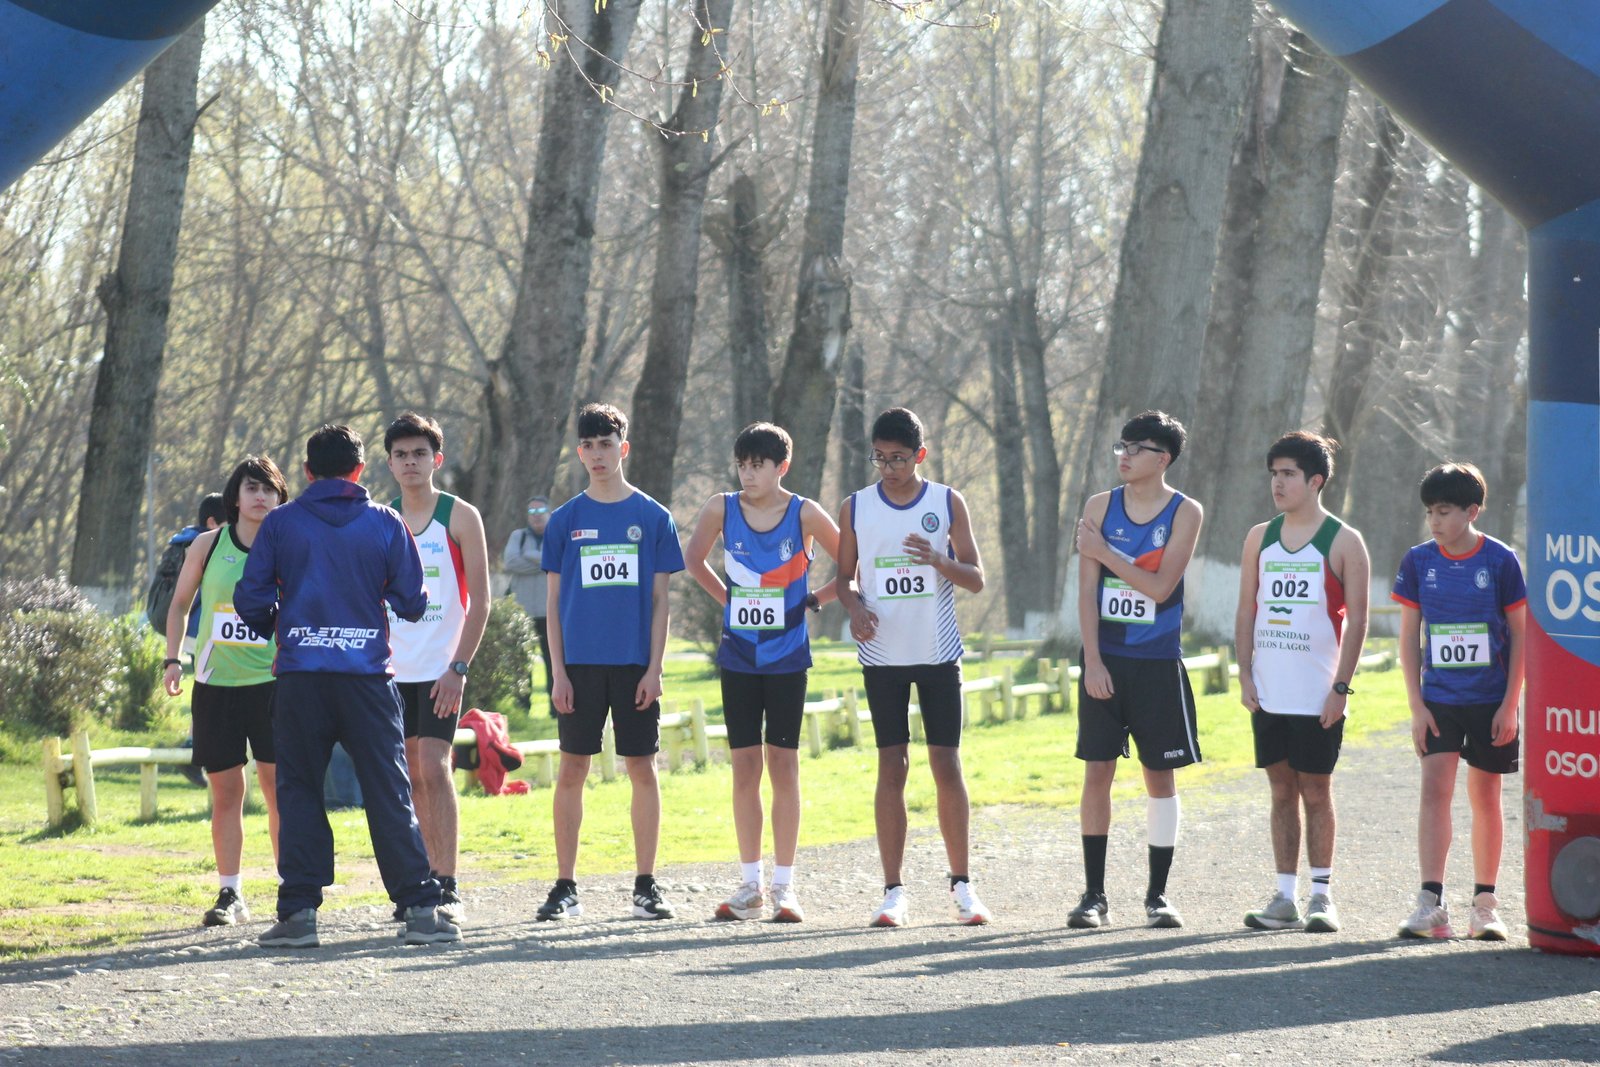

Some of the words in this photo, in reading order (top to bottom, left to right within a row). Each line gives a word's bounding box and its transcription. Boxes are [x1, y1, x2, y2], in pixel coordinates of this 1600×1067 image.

[1546, 533, 1600, 564] MUN
[590, 562, 629, 581] 004
[896, 567, 910, 575] U16
[885, 575, 925, 595] 003
[1119, 590, 1133, 598] U16
[1271, 579, 1309, 598] 002
[1546, 569, 1600, 622] OS
[737, 607, 775, 625] 006
[1108, 597, 1146, 618] 005
[420, 614, 443, 622] AGOS
[287, 626, 380, 639] ATLETISMO
[297, 636, 367, 651] OSORNO
[1279, 642, 1311, 652] LAGOS
[1439, 644, 1479, 663] 007
[1545, 706, 1600, 735] mu
[1545, 749, 1600, 778] oso
